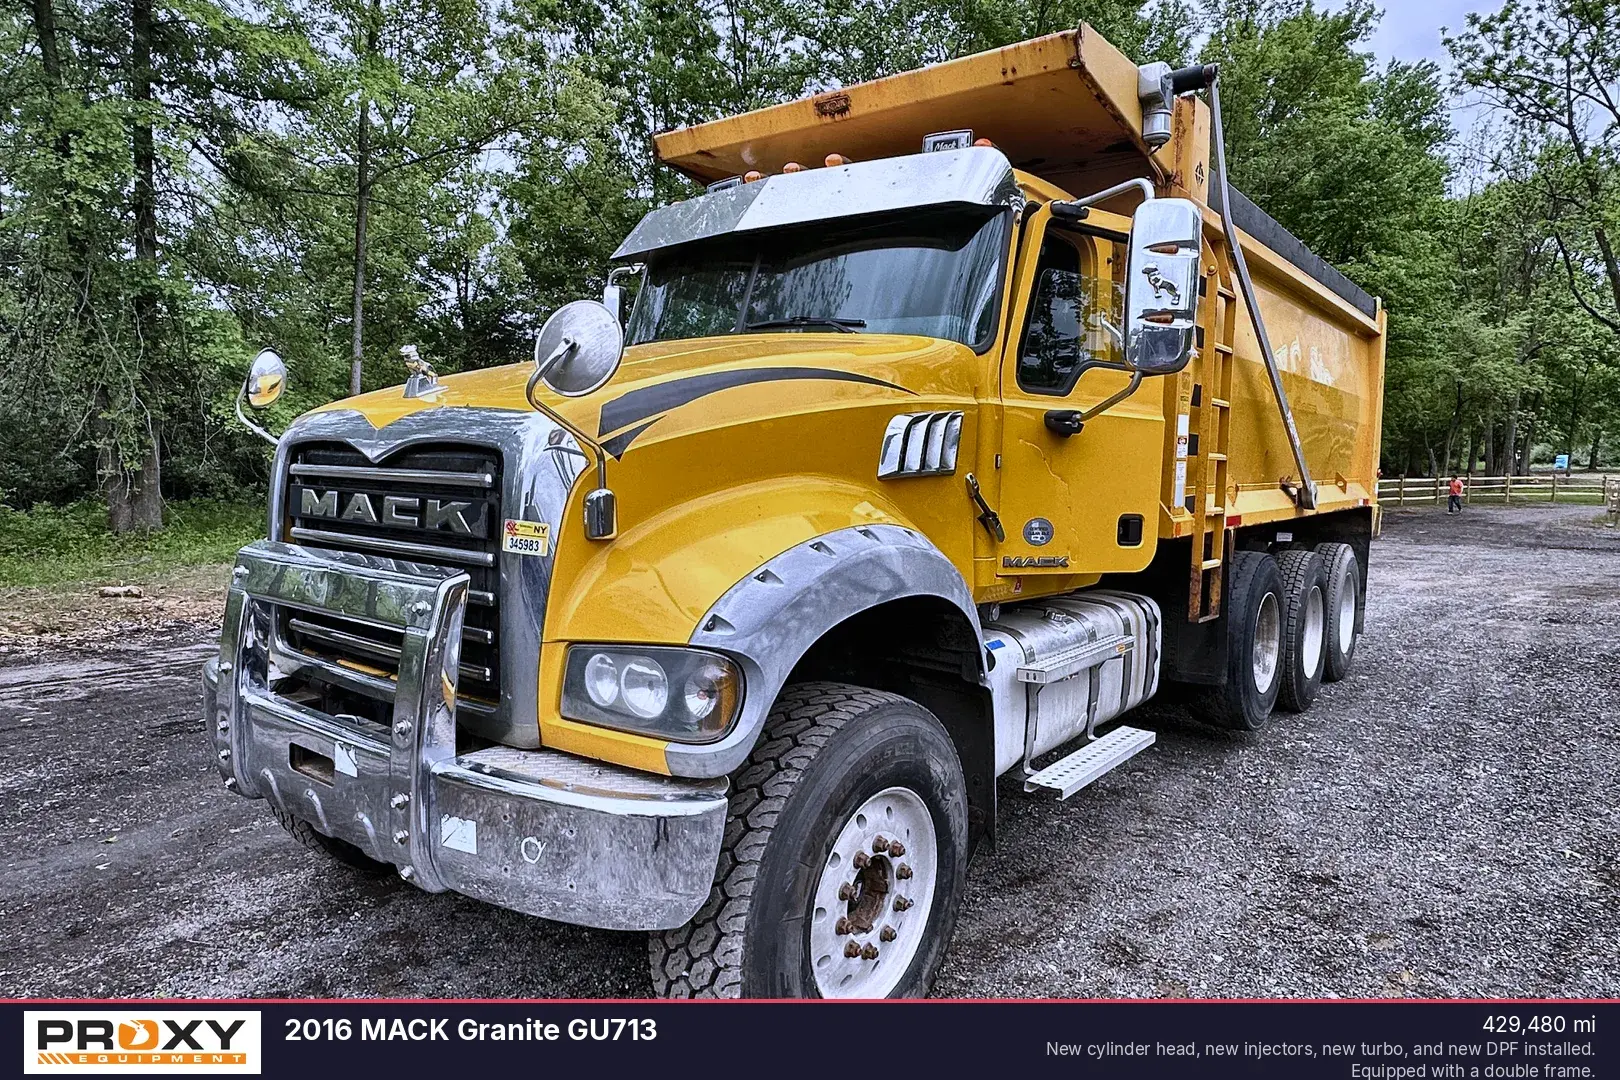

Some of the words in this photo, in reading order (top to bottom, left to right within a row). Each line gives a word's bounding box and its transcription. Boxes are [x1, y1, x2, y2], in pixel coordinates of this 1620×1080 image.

[934, 140, 957, 152] Mack
[302, 488, 472, 534] MACK
[533, 525, 547, 534] NY
[509, 537, 540, 552] 345983
[1003, 556, 1069, 568] MACK
